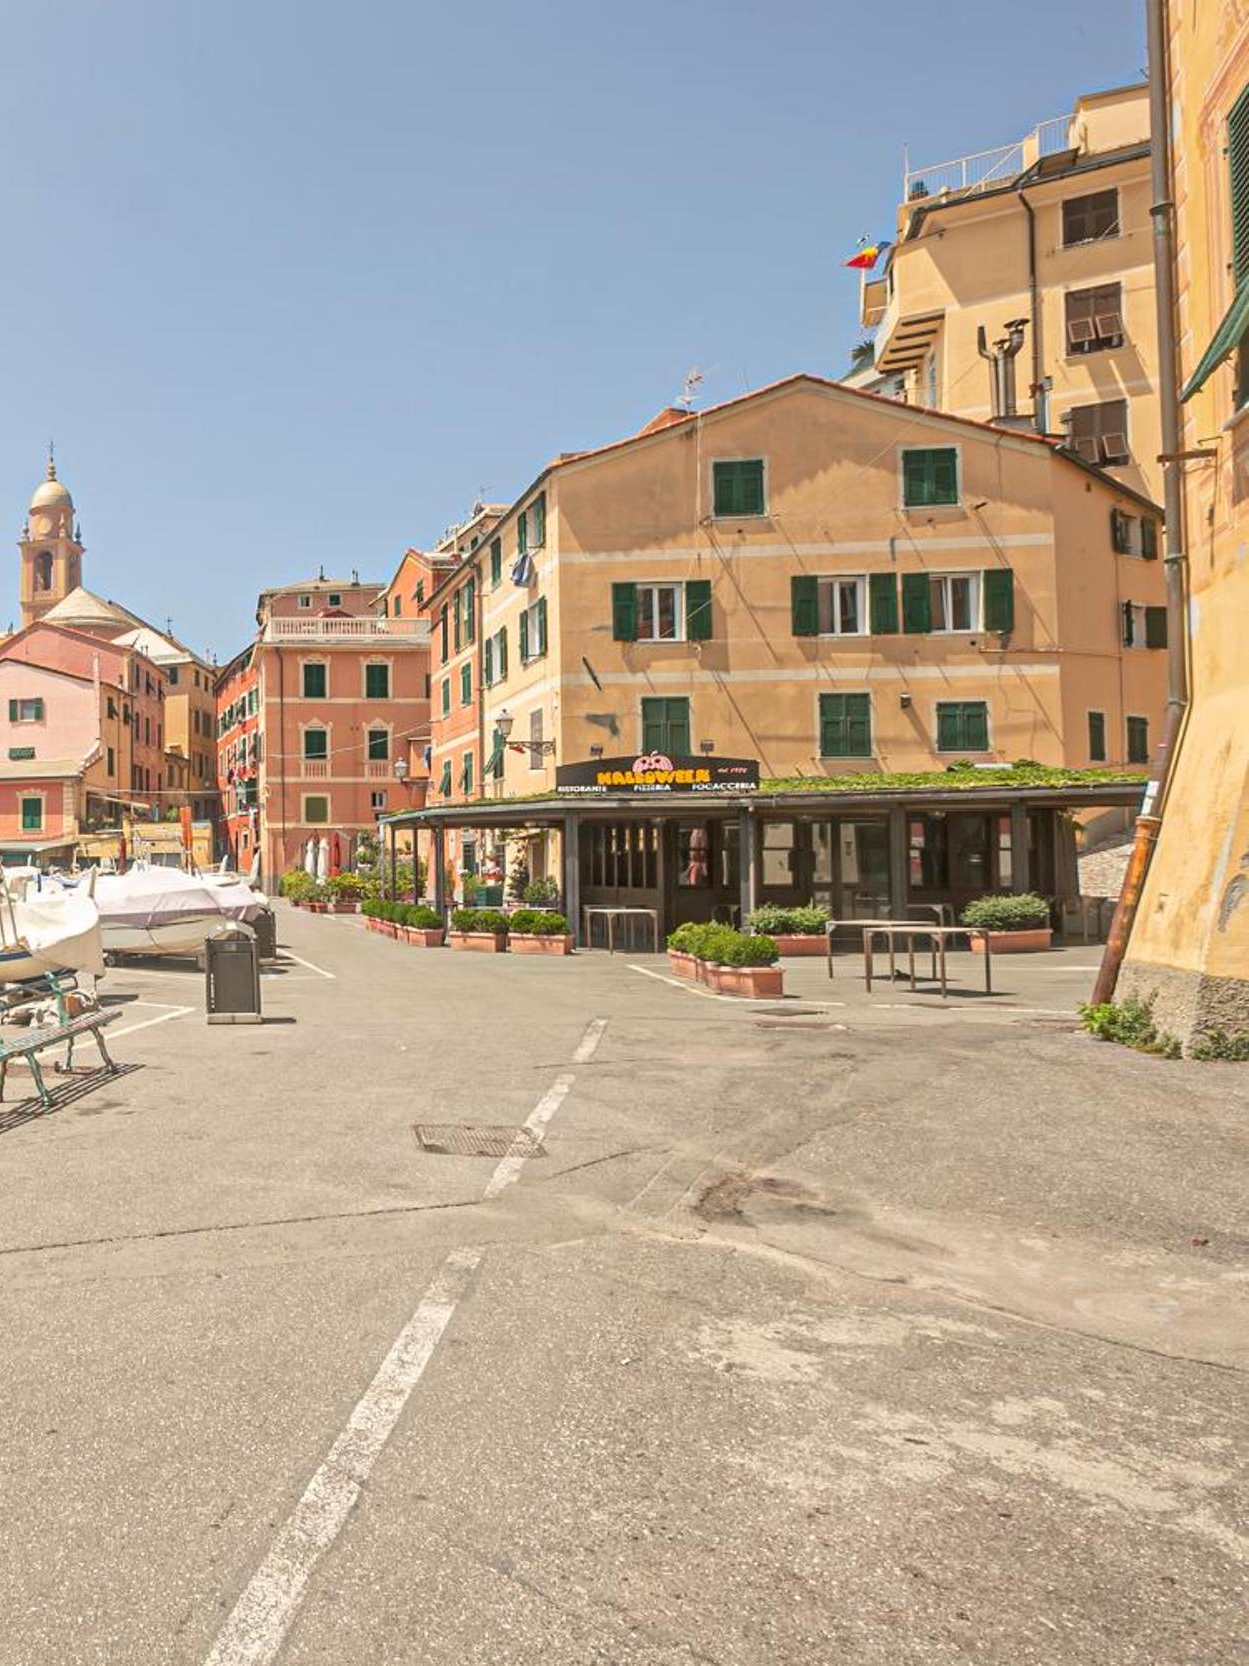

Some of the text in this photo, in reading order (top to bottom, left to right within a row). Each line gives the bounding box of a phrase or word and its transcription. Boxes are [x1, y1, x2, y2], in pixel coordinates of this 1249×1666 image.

[596, 769, 710, 785] HALLOWEEN
[557, 781, 757, 793] RISTORANTE PIZZERIA FOCACCERIA
